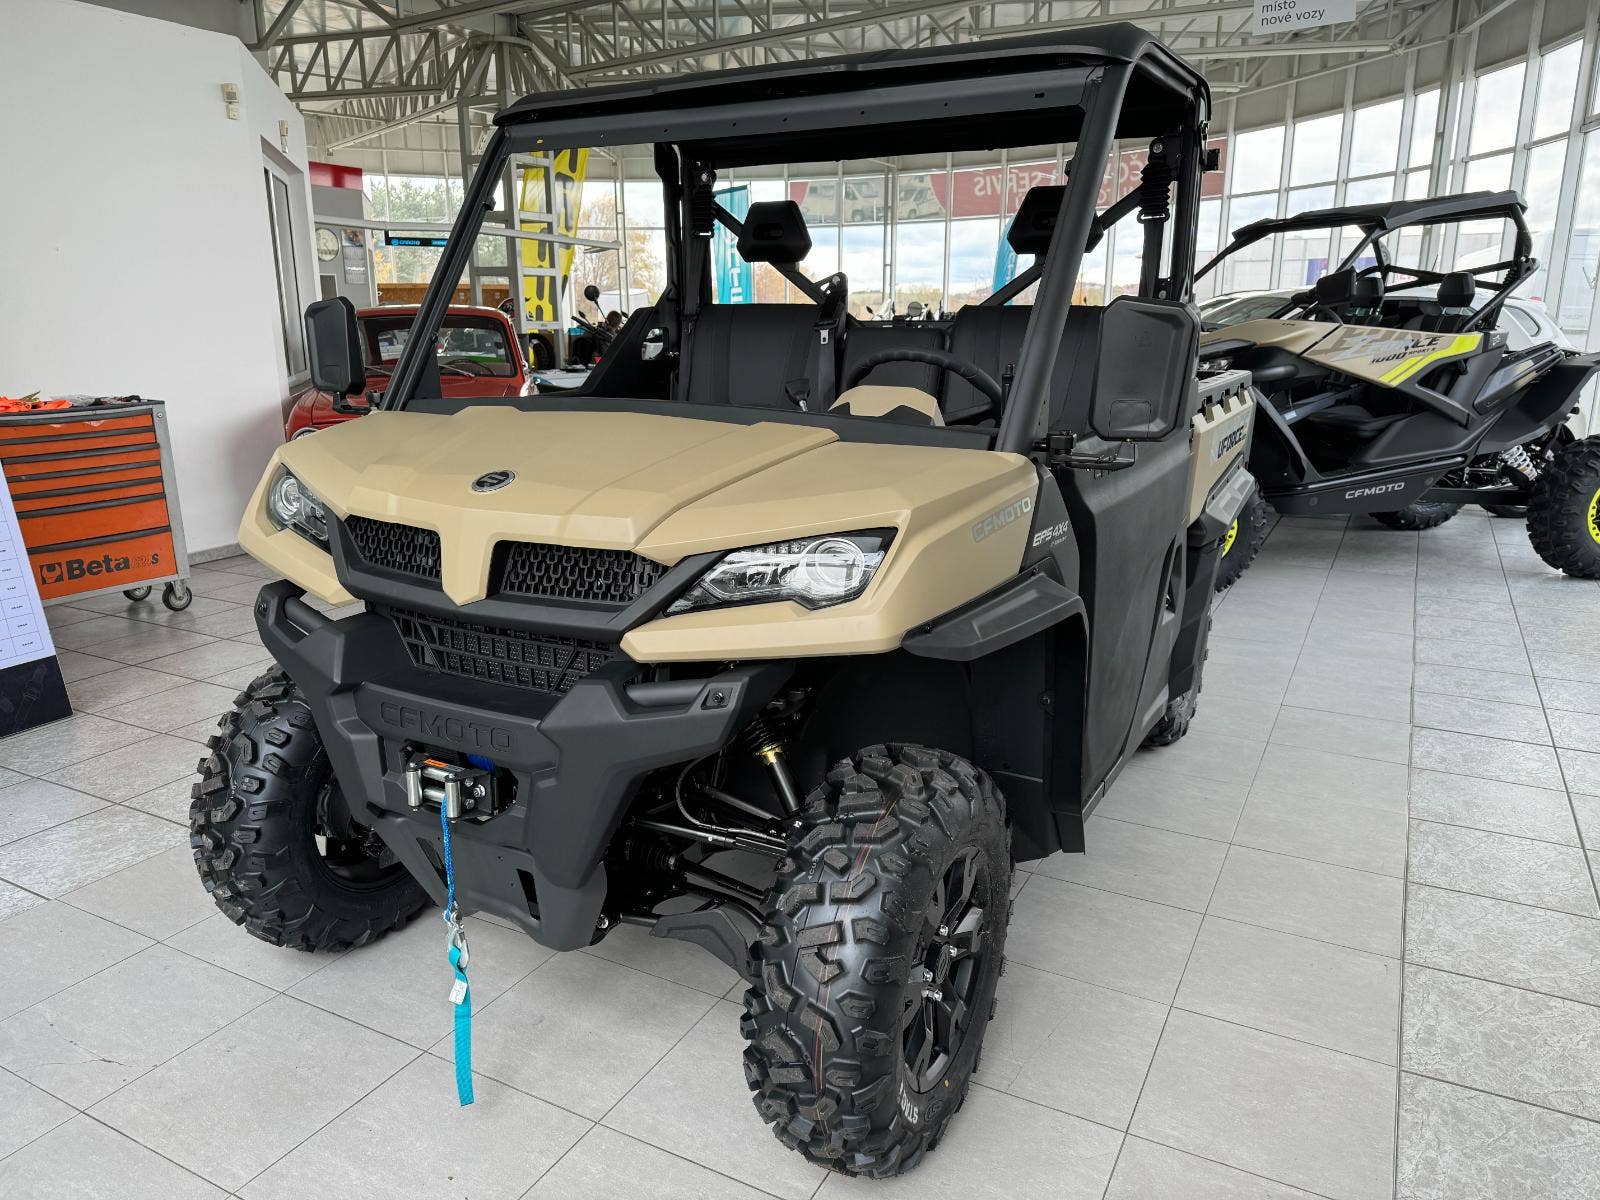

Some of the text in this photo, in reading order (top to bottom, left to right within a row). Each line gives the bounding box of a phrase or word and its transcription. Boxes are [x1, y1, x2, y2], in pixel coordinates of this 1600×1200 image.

[1261, 9, 1325, 26] nové vozy
[1345, 482, 1405, 499] CFMOTO
[972, 497, 1031, 543] CFMOTO
[1032, 526, 1053, 547] EPS
[66, 554, 130, 581] Beta
[380, 701, 512, 751] CFMOTO
